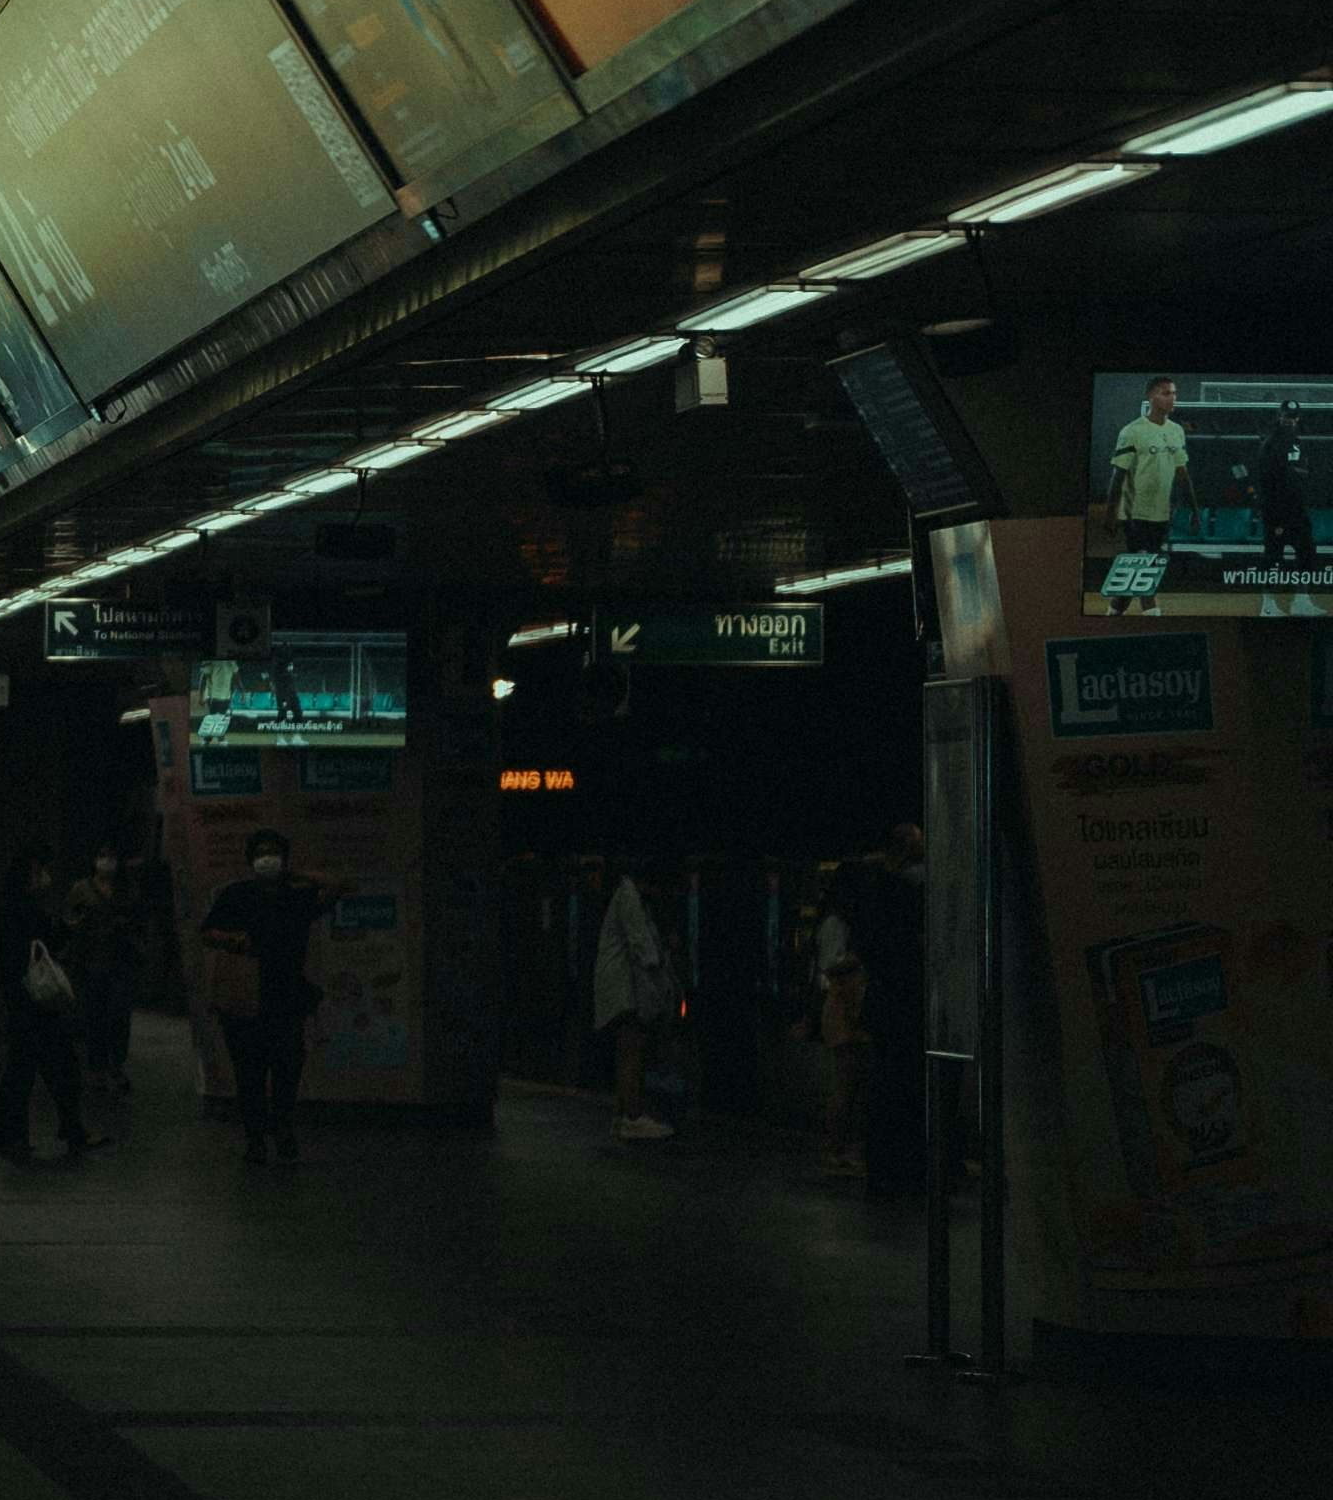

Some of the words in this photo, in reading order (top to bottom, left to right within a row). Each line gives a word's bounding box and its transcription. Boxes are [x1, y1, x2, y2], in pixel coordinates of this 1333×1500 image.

[713, 612, 807, 637] ทางออก
[768, 637, 805, 656] Exit
[1055, 652, 1204, 725] Lactasoy
[500, 769, 542, 792] ANG
[544, 769, 575, 792] WA
